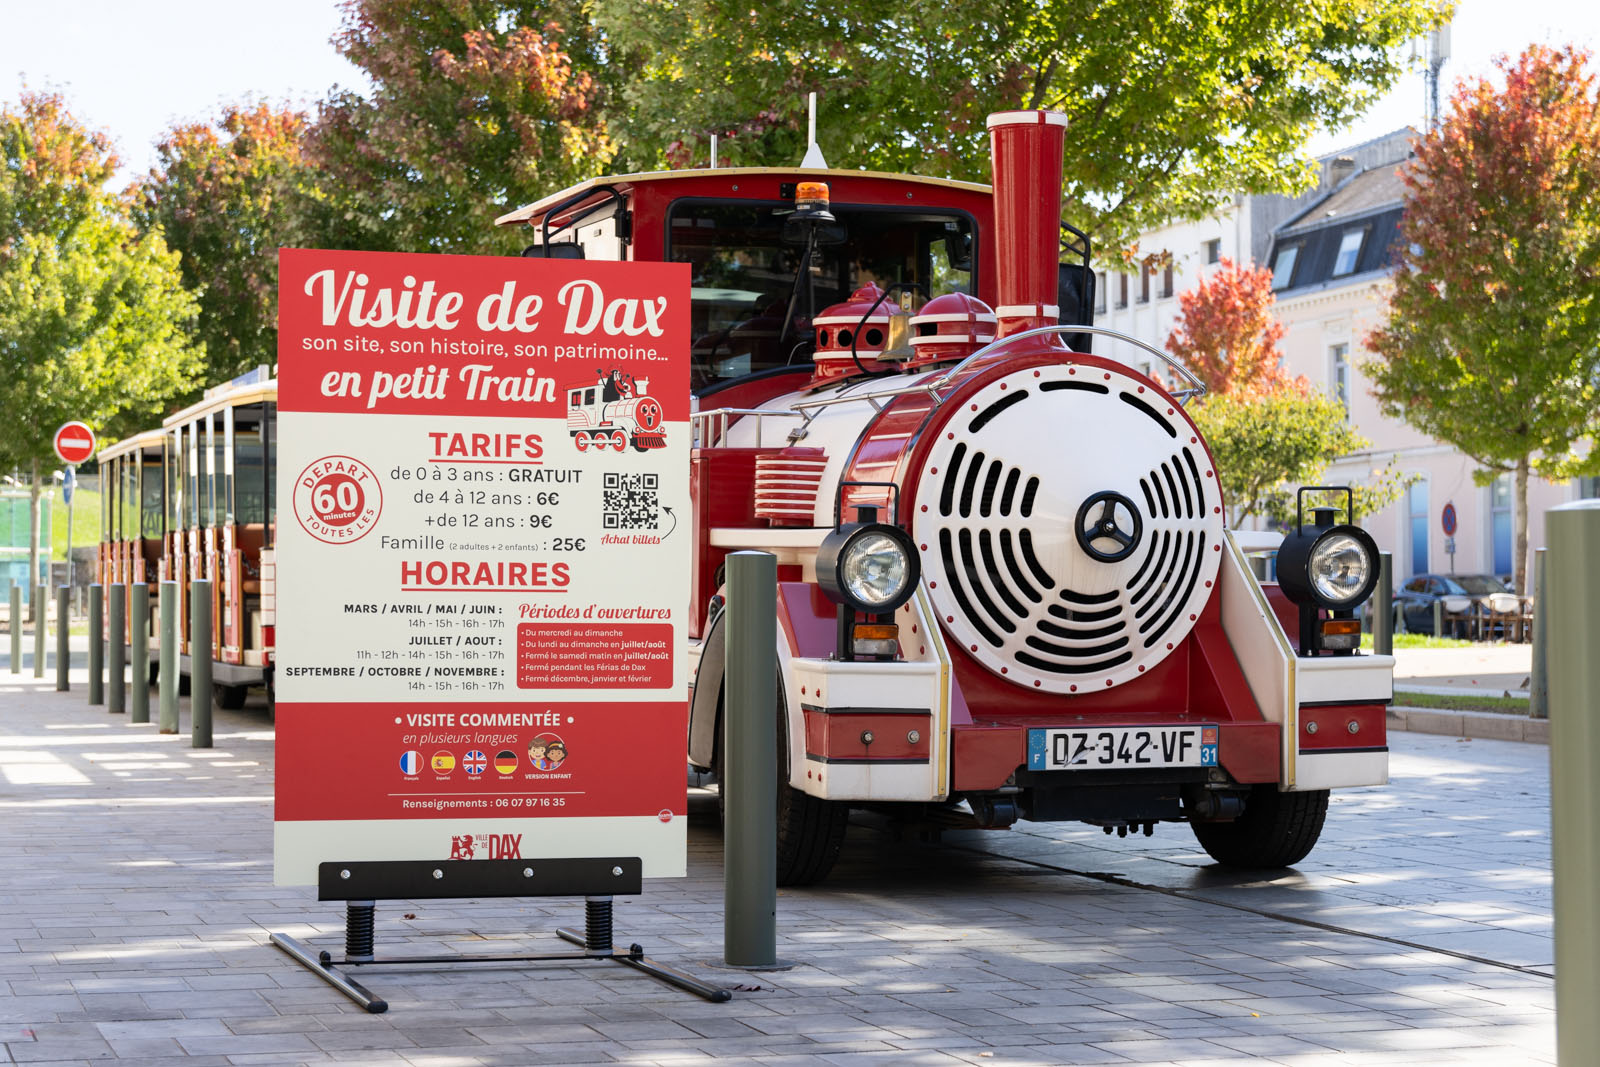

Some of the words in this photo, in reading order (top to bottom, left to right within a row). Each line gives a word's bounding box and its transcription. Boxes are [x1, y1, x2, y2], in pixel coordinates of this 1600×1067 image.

[304, 270, 463, 330] Visite
[477, 281, 543, 333] de
[558, 280, 667, 337] Dax
[303, 338, 336, 350] son
[344, 336, 384, 354] site,
[390, 341, 423, 353] son
[432, 338, 508, 357] histoire,
[514, 345, 547, 357] son
[321, 371, 362, 397] en
[367, 365, 450, 409] petit
[459, 364, 556, 402] Train
[429, 432, 543, 458] TARIFS
[303, 461, 368, 488] DEPART
[391, 466, 410, 480] de
[417, 467, 426, 480] 0
[433, 465, 441, 480] à
[448, 468, 457, 480] 3
[464, 471, 493, 481] ans
[509, 469, 582, 483] GRATUIT
[313, 482, 358, 514] 60
[414, 490, 433, 503] de
[439, 491, 449, 503] 4
[455, 489, 463, 504] à
[470, 491, 485, 504] 12
[492, 495, 521, 505] ans
[537, 492, 559, 505] 6€
[306, 515, 353, 537] TOUTES
[357, 508, 374, 529] LES
[323, 511, 356, 521] minutes
[463, 514, 478, 527] 12
[485, 517, 514, 527] ans
[530, 515, 552, 528] 9€
[382, 536, 444, 549] Famille
[505, 544, 538, 552] enfants)
[553, 538, 585, 551] 25€
[601, 534, 630, 544] Achat
[632, 535, 660, 544] billets
[402, 561, 570, 586] HORAIRES
[345, 605, 377, 614] MARS
[391, 605, 423, 614] AVRIL
[436, 605, 456, 614] MAI
[469, 606, 495, 615] JUIN
[519, 604, 579, 618] Périodes
[409, 619, 425, 628] 14h
[436, 619, 452, 628] 15h
[463, 619, 479, 628] 16h
[489, 619, 504, 628] 17h
[526, 629, 536, 637] Du
[409, 637, 452, 646] JUILLET
[465, 637, 495, 646] AOUT
[538, 641, 557, 649] lundi
[571, 641, 609, 649] dimanche
[621, 641, 665, 650] juillet/août
[357, 651, 371, 660] 11h
[382, 650, 398, 659] 12h
[409, 651, 425, 660] 14h
[436, 651, 452, 660] 15h
[462, 651, 478, 660] 16h
[489, 651, 504, 660] 17h
[526, 652, 549, 660] Fermé
[551, 652, 557, 660] le
[559, 652, 587, 660] samedi
[589, 652, 612, 660] matin
[624, 652, 668, 661] juillet/août
[286, 667, 355, 676] SEPTEMBRE
[368, 668, 421, 677] OCTOBRE
[435, 668, 497, 677] NOVEMBRE
[526, 663, 549, 671] Fermé
[551, 664, 582, 673] pendant
[584, 664, 595, 672] les
[597, 663, 619, 671] Férias
[409, 682, 425, 691] 14h
[436, 682, 452, 691] 15h
[462, 682, 478, 691] 16h
[489, 682, 504, 691] 17h
[526, 675, 549, 683] Fermé
[551, 675, 590, 683] décembre,
[591, 675, 617, 684] janvier
[628, 675, 651, 683] février
[407, 714, 454, 726] VISITE
[460, 710, 560, 726] COMMENTÉE
[403, 735, 416, 744] en
[419, 732, 471, 746] plusieurs
[474, 732, 517, 746] langues
[1034, 754, 1040, 763] F
[1202, 748, 1216, 763] 31
[403, 799, 487, 810] Renseignements
[496, 799, 508, 808] 06
[511, 799, 523, 807] 07
[526, 799, 537, 807] 97
[540, 798, 550, 807] 16
[553, 798, 565, 807] 35
[475, 834, 488, 842] VILLE
[488, 834, 522, 860] DAX
